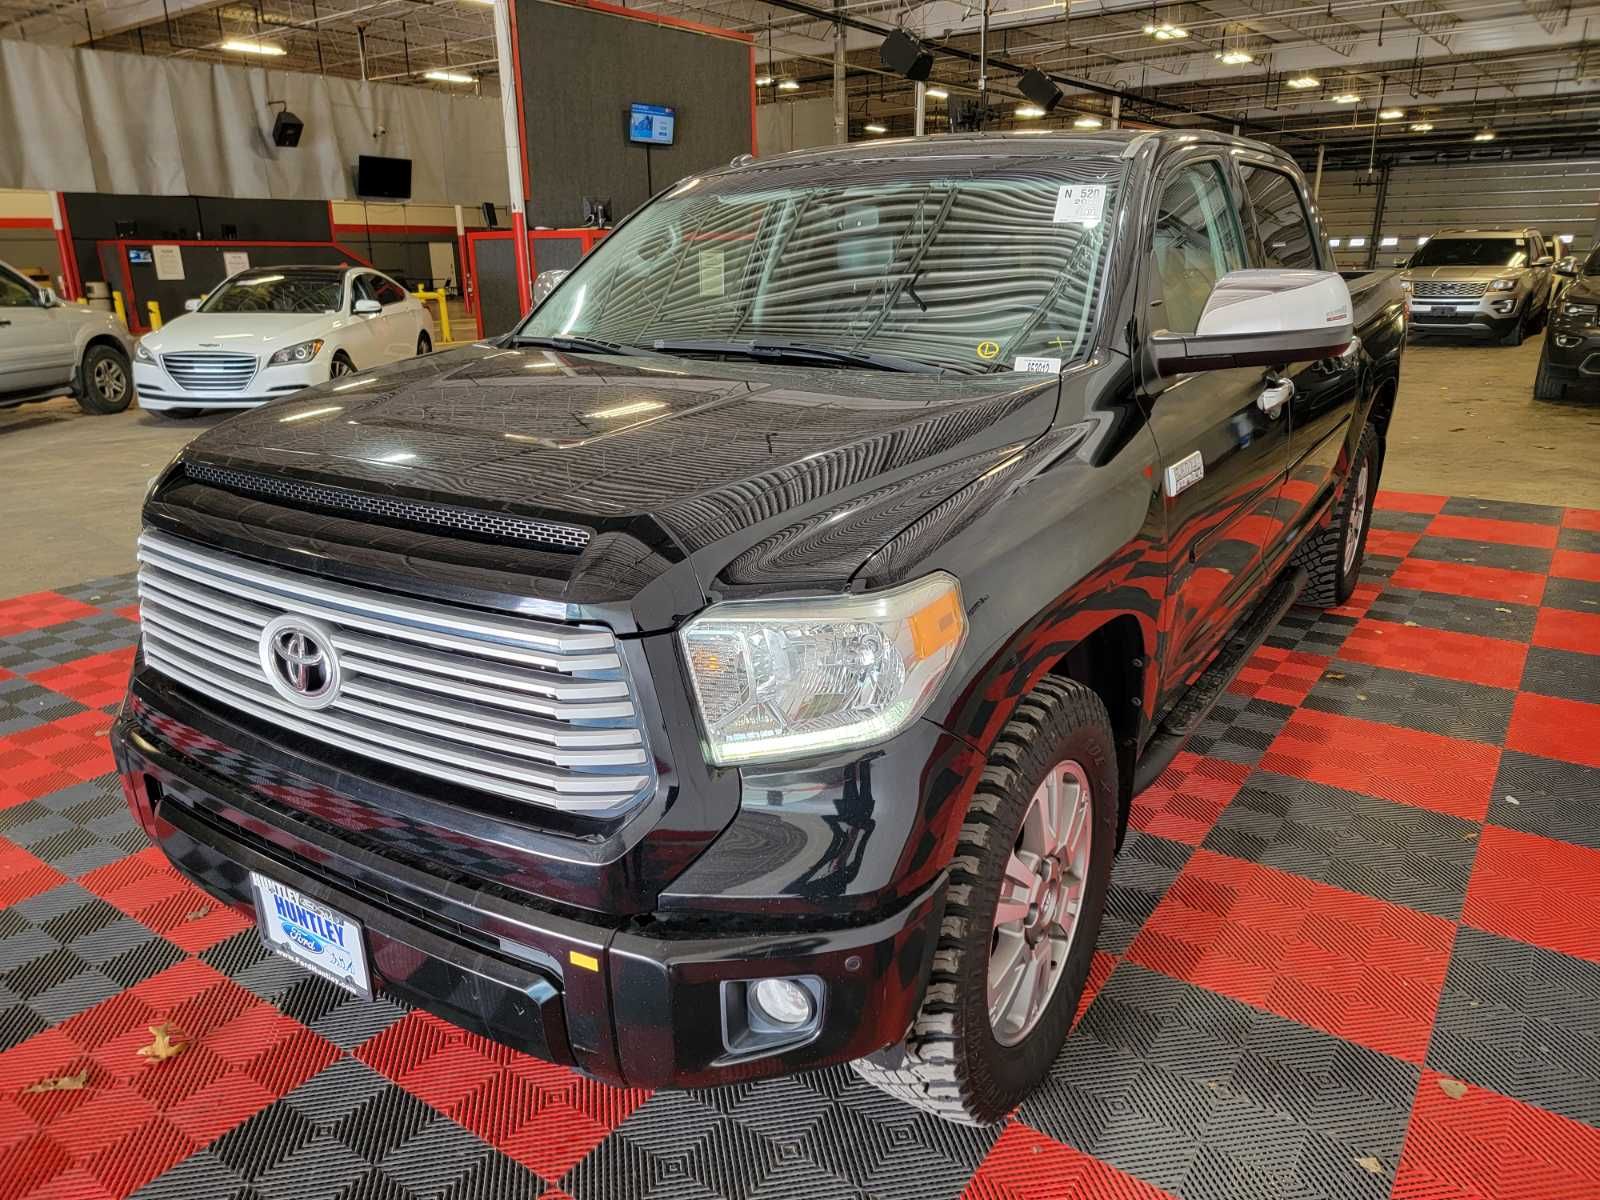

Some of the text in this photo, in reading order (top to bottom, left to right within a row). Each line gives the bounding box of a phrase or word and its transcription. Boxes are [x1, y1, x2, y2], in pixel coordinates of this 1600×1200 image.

[1064, 189, 1073, 199] N
[274, 894, 345, 947] HUNTLEY
[288, 925, 317, 952] Ford
